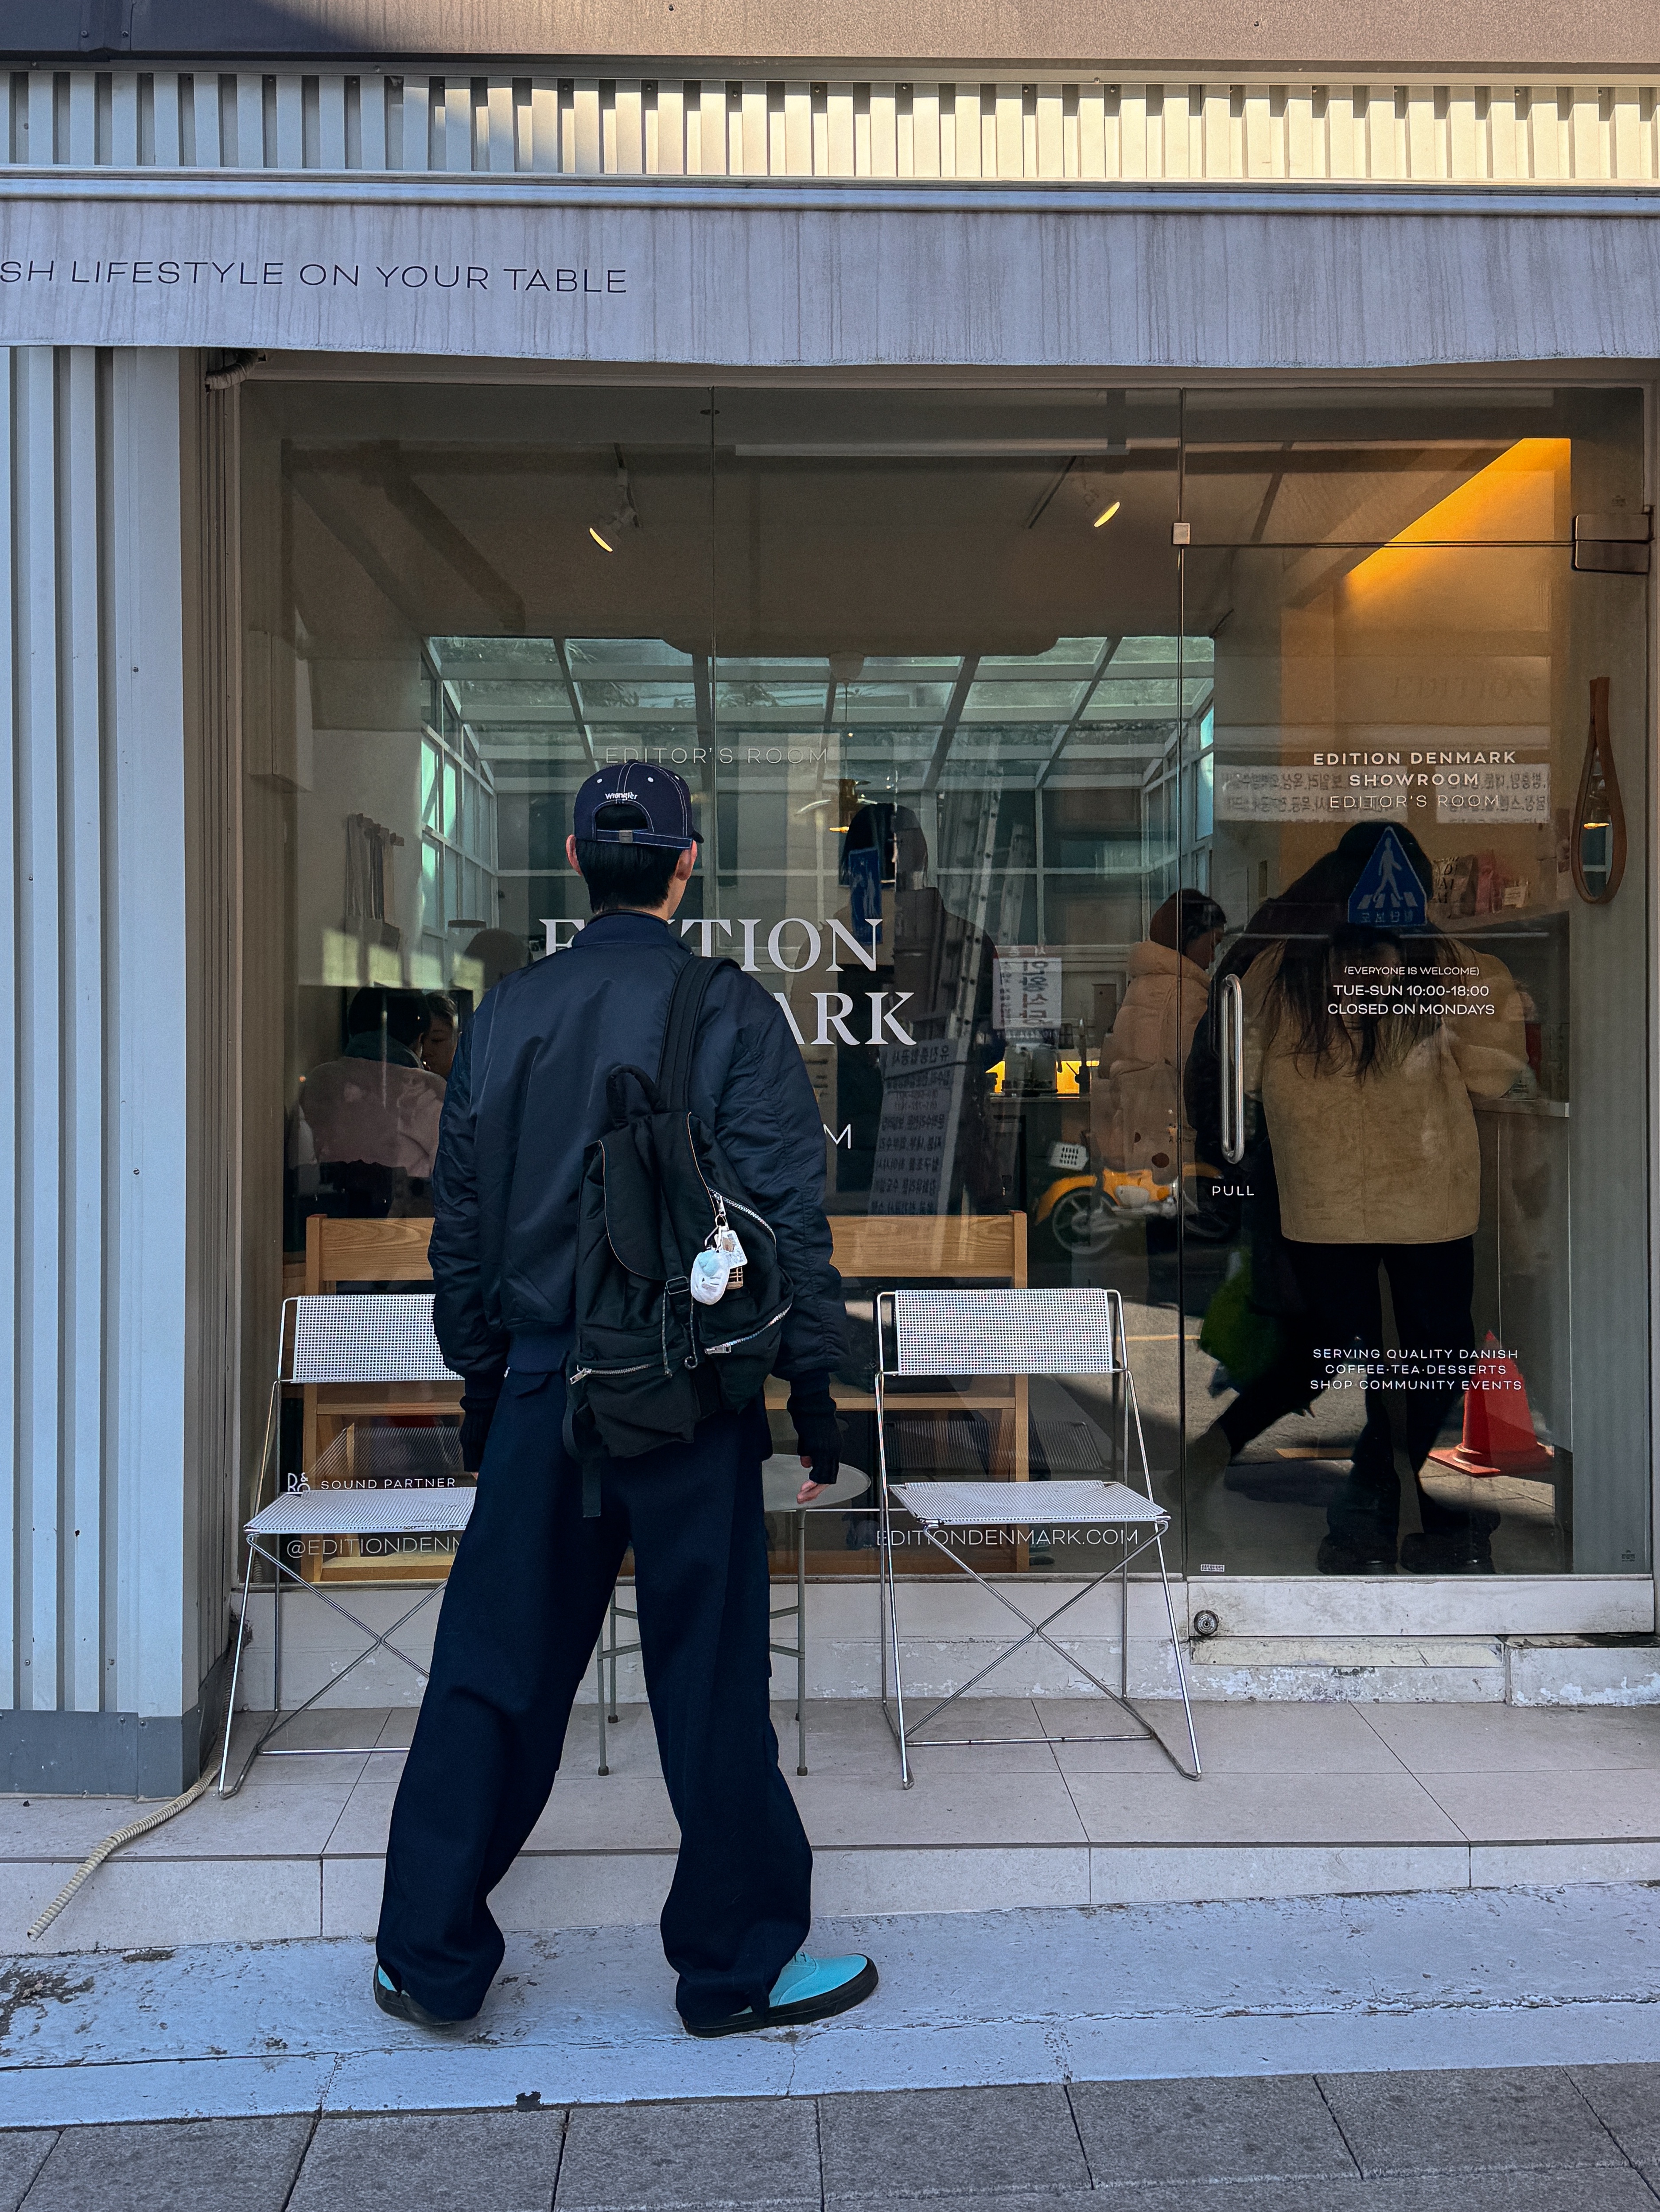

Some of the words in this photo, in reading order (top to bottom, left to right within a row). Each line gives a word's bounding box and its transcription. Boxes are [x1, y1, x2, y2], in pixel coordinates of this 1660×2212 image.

[72, 260, 284, 285] LIFESTYLE
[299, 264, 359, 287] ON
[376, 265, 488, 290] YOUR
[503, 268, 626, 293] TABLE
[606, 748, 733, 764] EDITOR'S
[747, 748, 828, 764] ROOM
[1313, 752, 1400, 765] EDITION
[1411, 751, 1516, 764] DENMARK
[1349, 773, 1478, 787] SHOWROOM
[1330, 795, 1427, 808] EDITOR'S
[1438, 795, 1499, 808] ROOM
[538, 917, 883, 973] ETION
[1344, 966, 1405, 976] (EVERYONE
[1407, 966, 1418, 976] IS
[1419, 966, 1480, 976] WELCOME)
[1333, 985, 1403, 996] TUE-SUN
[1407, 985, 1489, 997] 10:00-18:00
[1327, 1003, 1389, 1015] CLOSED
[1392, 1004, 1415, 1015] ON
[1419, 1004, 1495, 1015] MONDAYS
[1212, 1185, 1255, 1196] PULL
[1313, 1348, 1380, 1359] SERVING
[1387, 1349, 1453, 1360] QUALITY
[1459, 1349, 1518, 1359] DANISH
[1310, 1380, 1353, 1390] SHOP
[1359, 1380, 1455, 1390] COMMUNITY
[1461, 1381, 1522, 1391] EVENTS
[320, 1479, 377, 1490] SOUND
[384, 1478, 456, 1489] PARTNER
